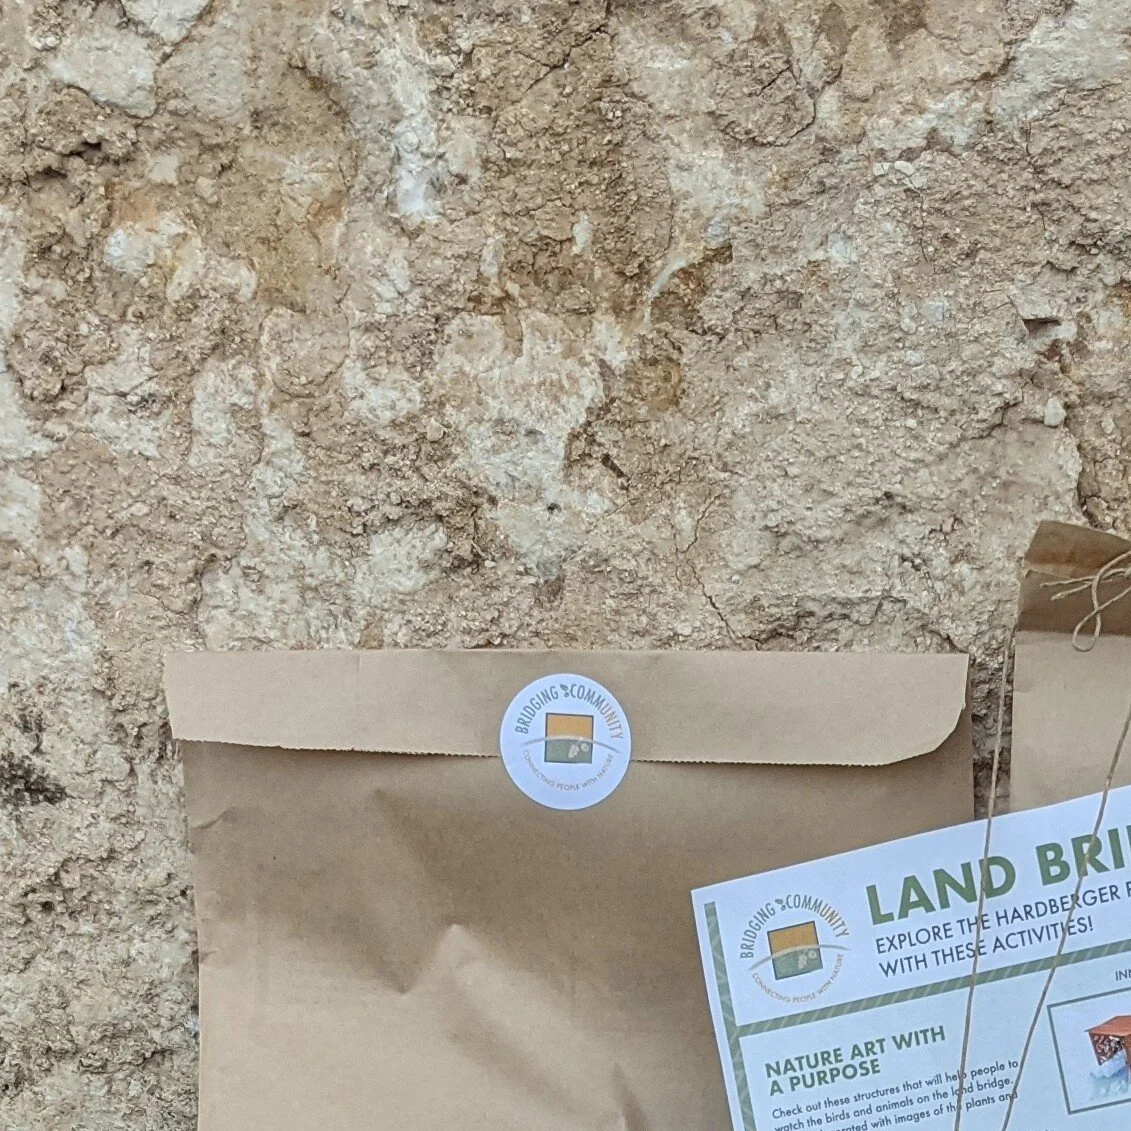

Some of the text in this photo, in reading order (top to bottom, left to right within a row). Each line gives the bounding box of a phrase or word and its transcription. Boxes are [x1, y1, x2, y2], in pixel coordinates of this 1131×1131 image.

[515, 684, 623, 739] BRIDGING COMMUNITY
[866, 854, 1016, 925] LAND
[875, 921, 953, 954] EXPLORE
[956, 911, 991, 935] THE
[995, 884, 1120, 926] HARDBERGER
[740, 894, 849, 958] BRIDGING COMMUNITY
[878, 915, 1093, 977] WITH THESE ACTIVITIES!
[765, 1025, 945, 1078] NATURE ART WITH
[770, 1058, 880, 1096] A PURPOSE
